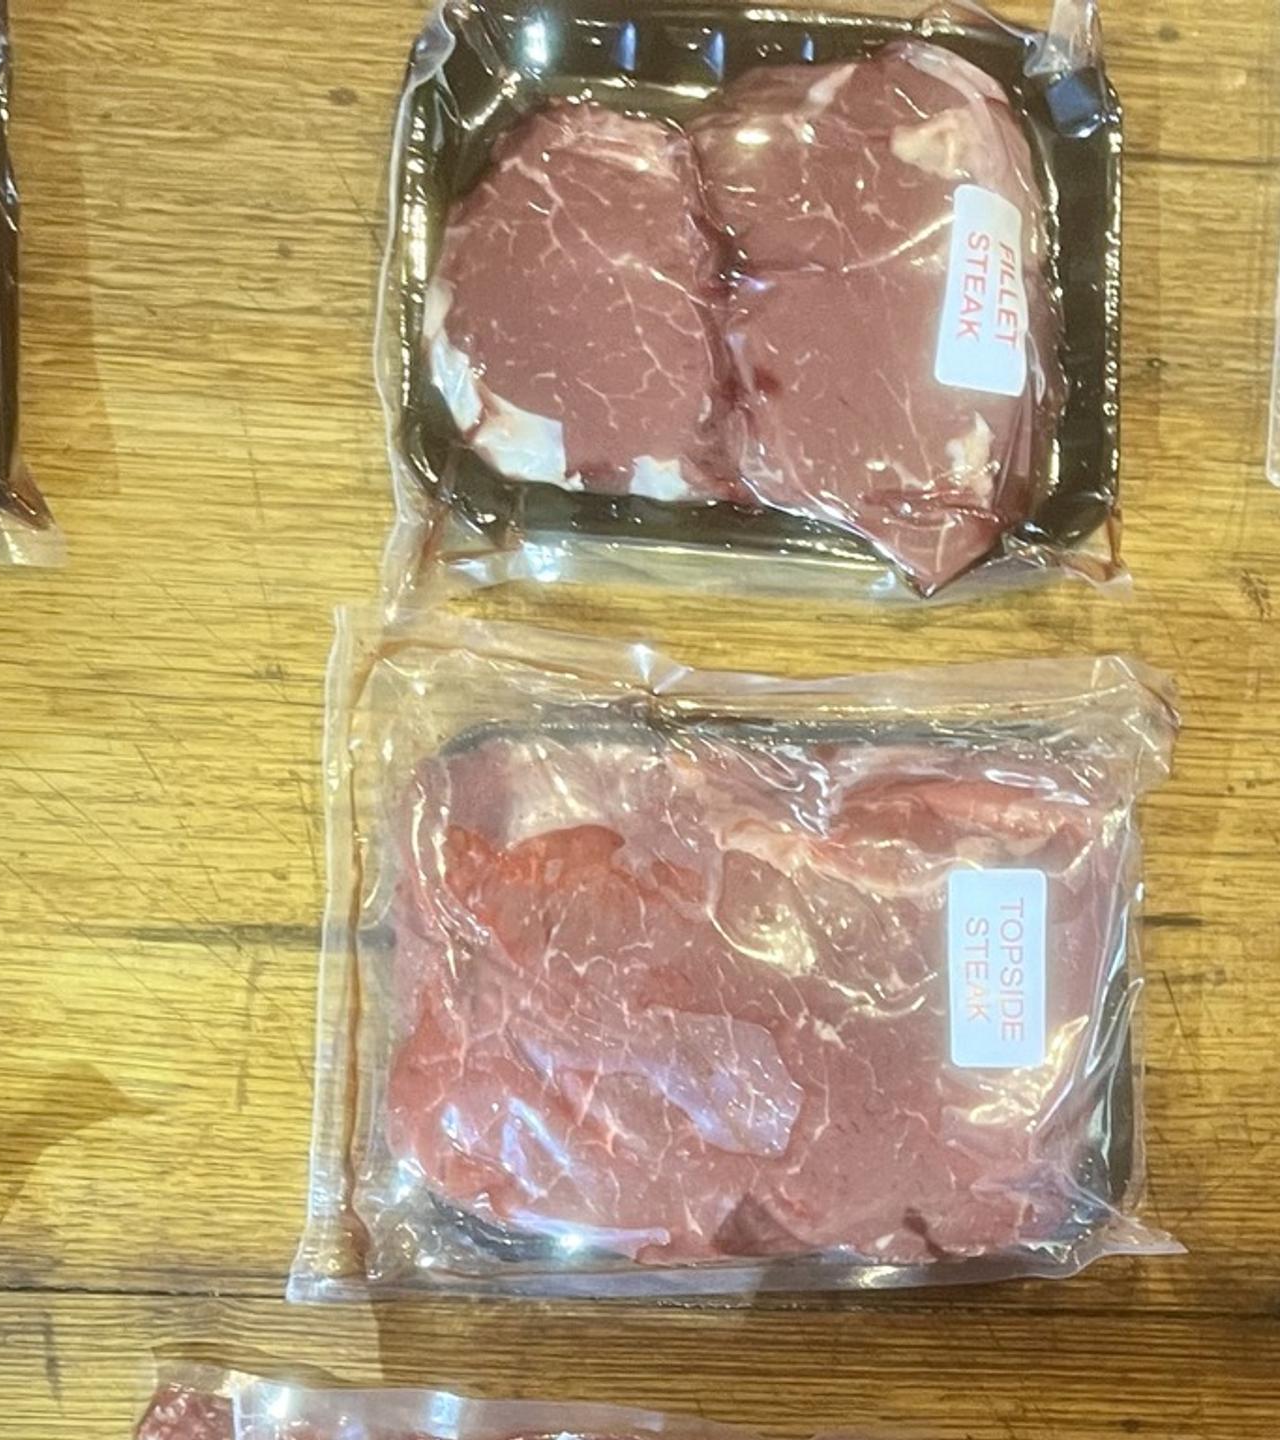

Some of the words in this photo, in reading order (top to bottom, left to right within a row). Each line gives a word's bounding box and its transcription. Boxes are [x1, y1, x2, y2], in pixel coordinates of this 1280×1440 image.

[956, 231, 990, 343] STEAK
[994, 241, 1019, 349] FILLET
[964, 917, 991, 1023] STEAK
[999, 898, 1024, 1042] TOPSIDE
